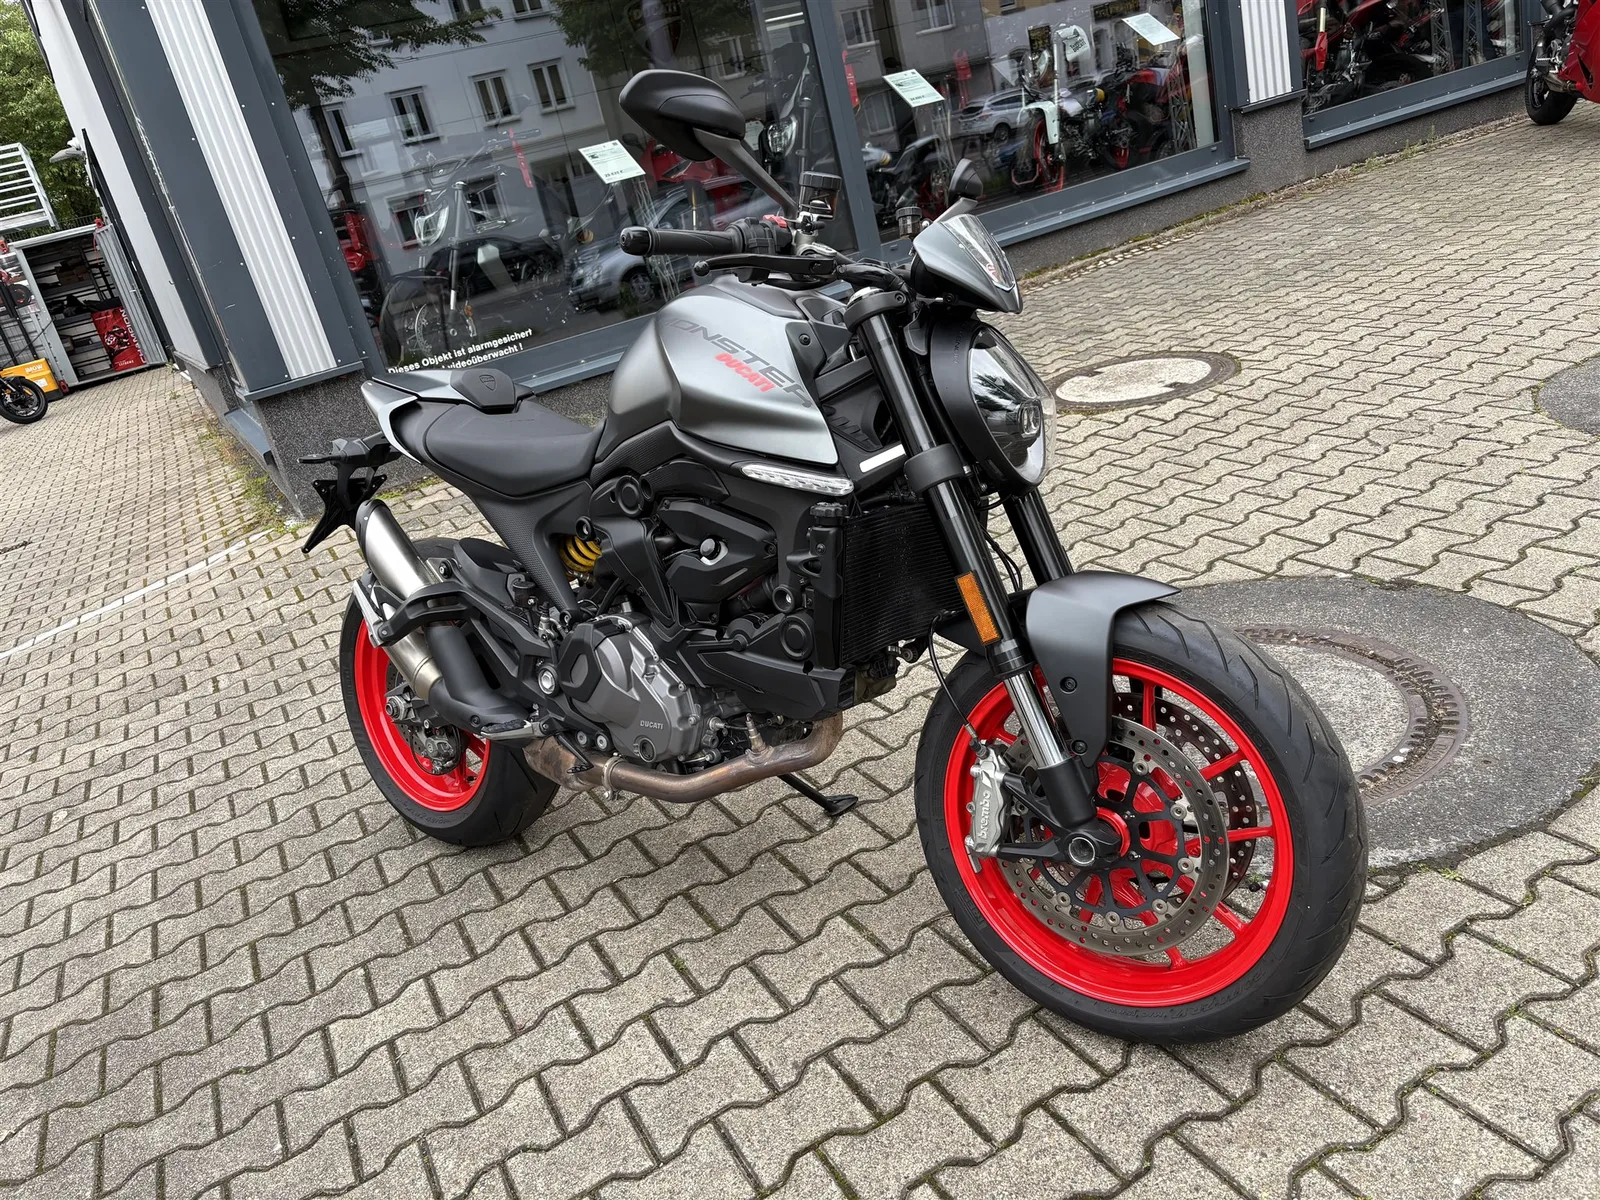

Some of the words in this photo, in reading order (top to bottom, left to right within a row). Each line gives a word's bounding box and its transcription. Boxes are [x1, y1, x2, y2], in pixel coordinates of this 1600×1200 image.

[388, 362, 421, 374] Dieses
[421, 353, 453, 368] Objekt
[453, 347, 467, 358] ist
[467, 328, 533, 355] alarmgesichert
[713, 351, 777, 393] DUCATI
[640, 720, 664, 730] DUCATI
[977, 789, 991, 840] brembo
